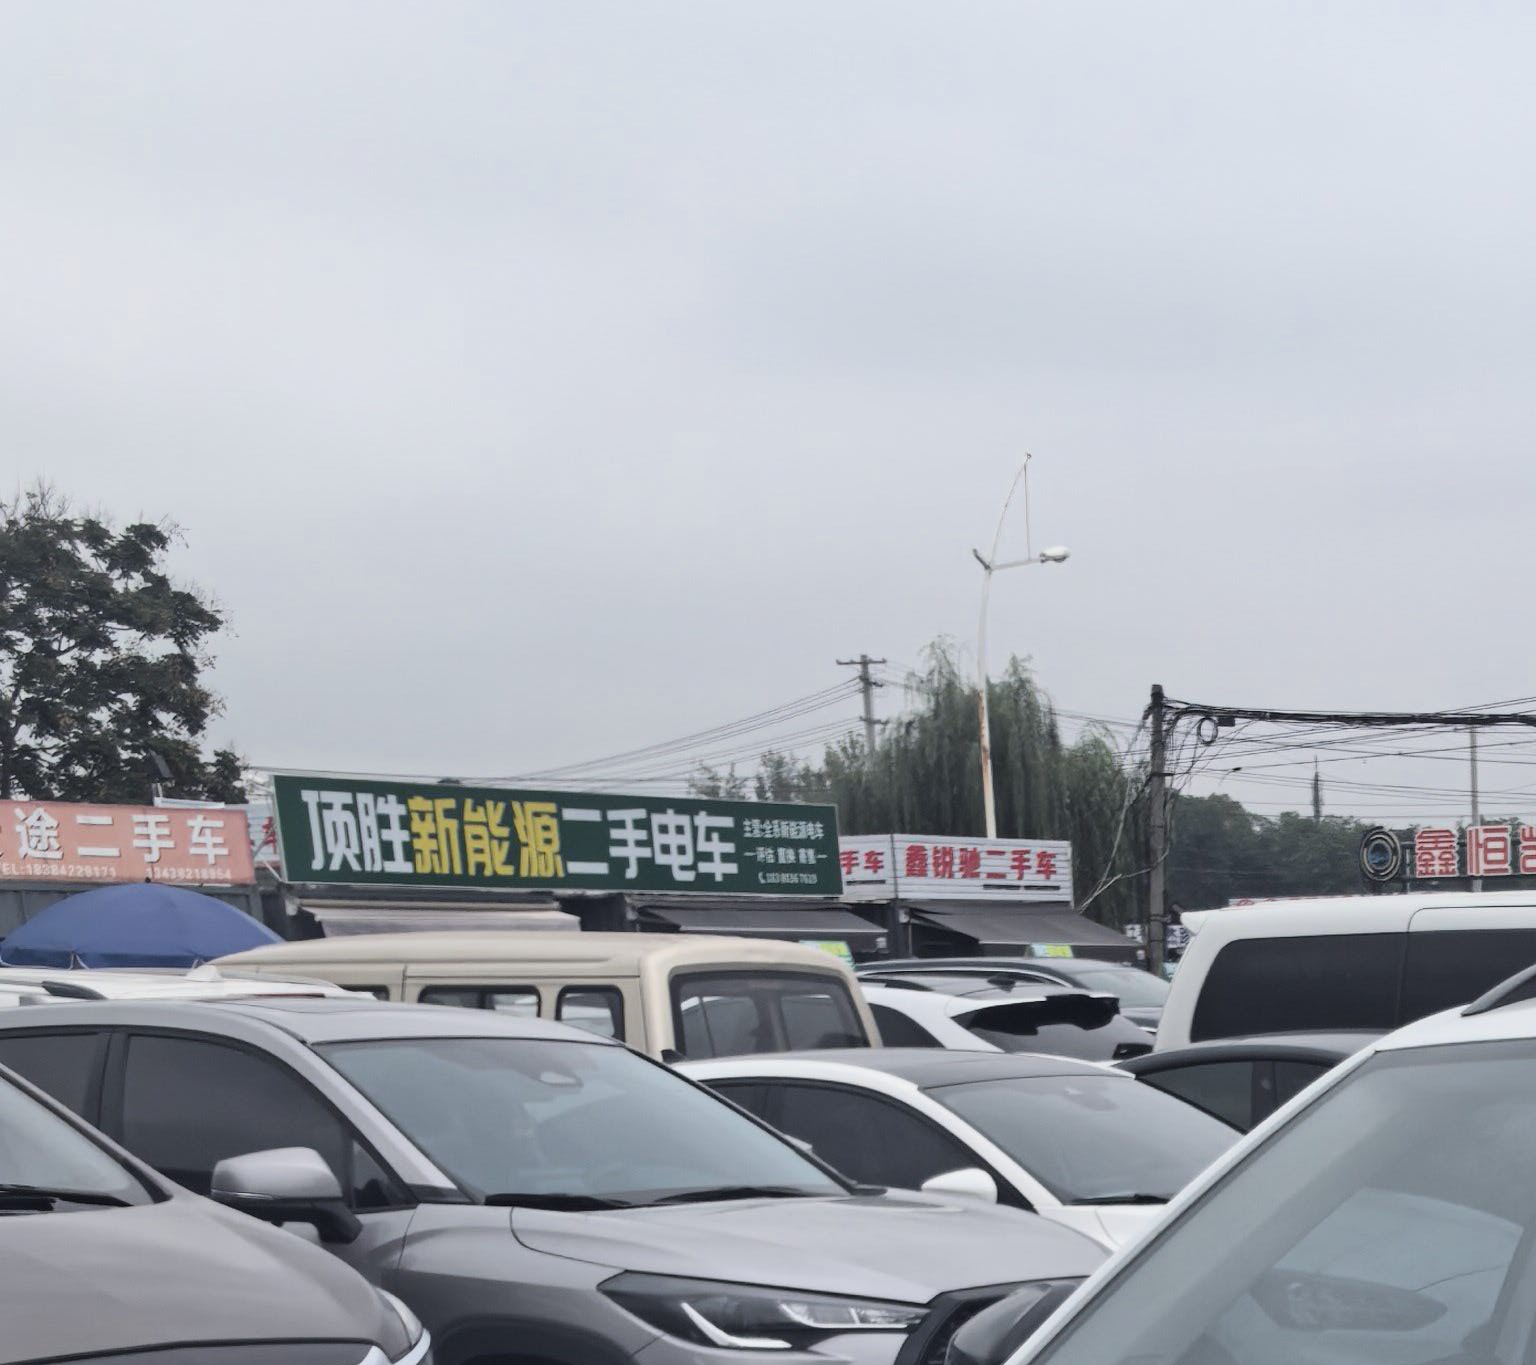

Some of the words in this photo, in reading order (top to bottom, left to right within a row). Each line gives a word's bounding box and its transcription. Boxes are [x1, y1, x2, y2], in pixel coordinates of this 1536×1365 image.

[13, 806, 229, 865] 途二手车
[300, 789, 738, 882] 顶胜新能源二手电车
